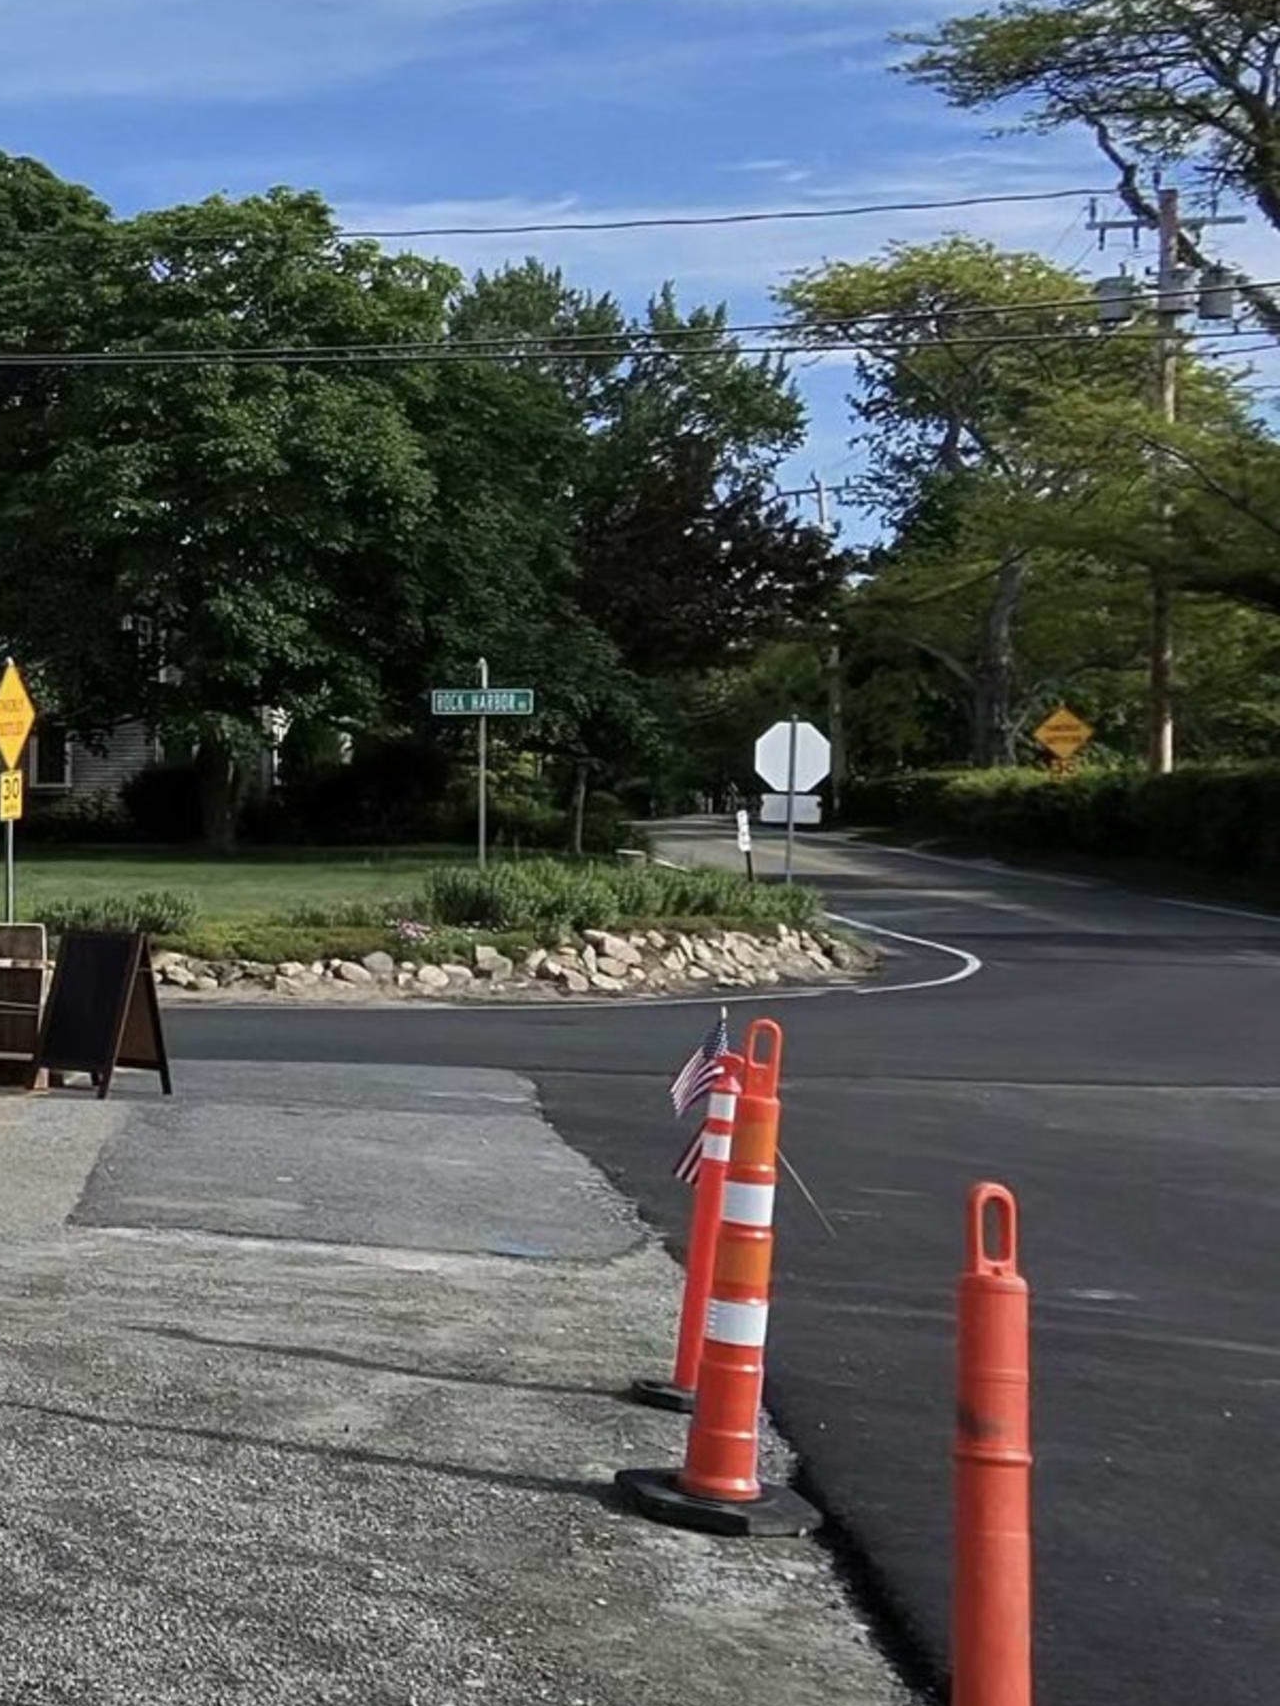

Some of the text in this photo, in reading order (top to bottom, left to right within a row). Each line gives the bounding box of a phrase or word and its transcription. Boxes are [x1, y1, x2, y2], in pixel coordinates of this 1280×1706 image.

[437, 694, 464, 711] ROCK
[471, 694, 515, 711] HARBOR
[3, 777, 20, 801] 30
